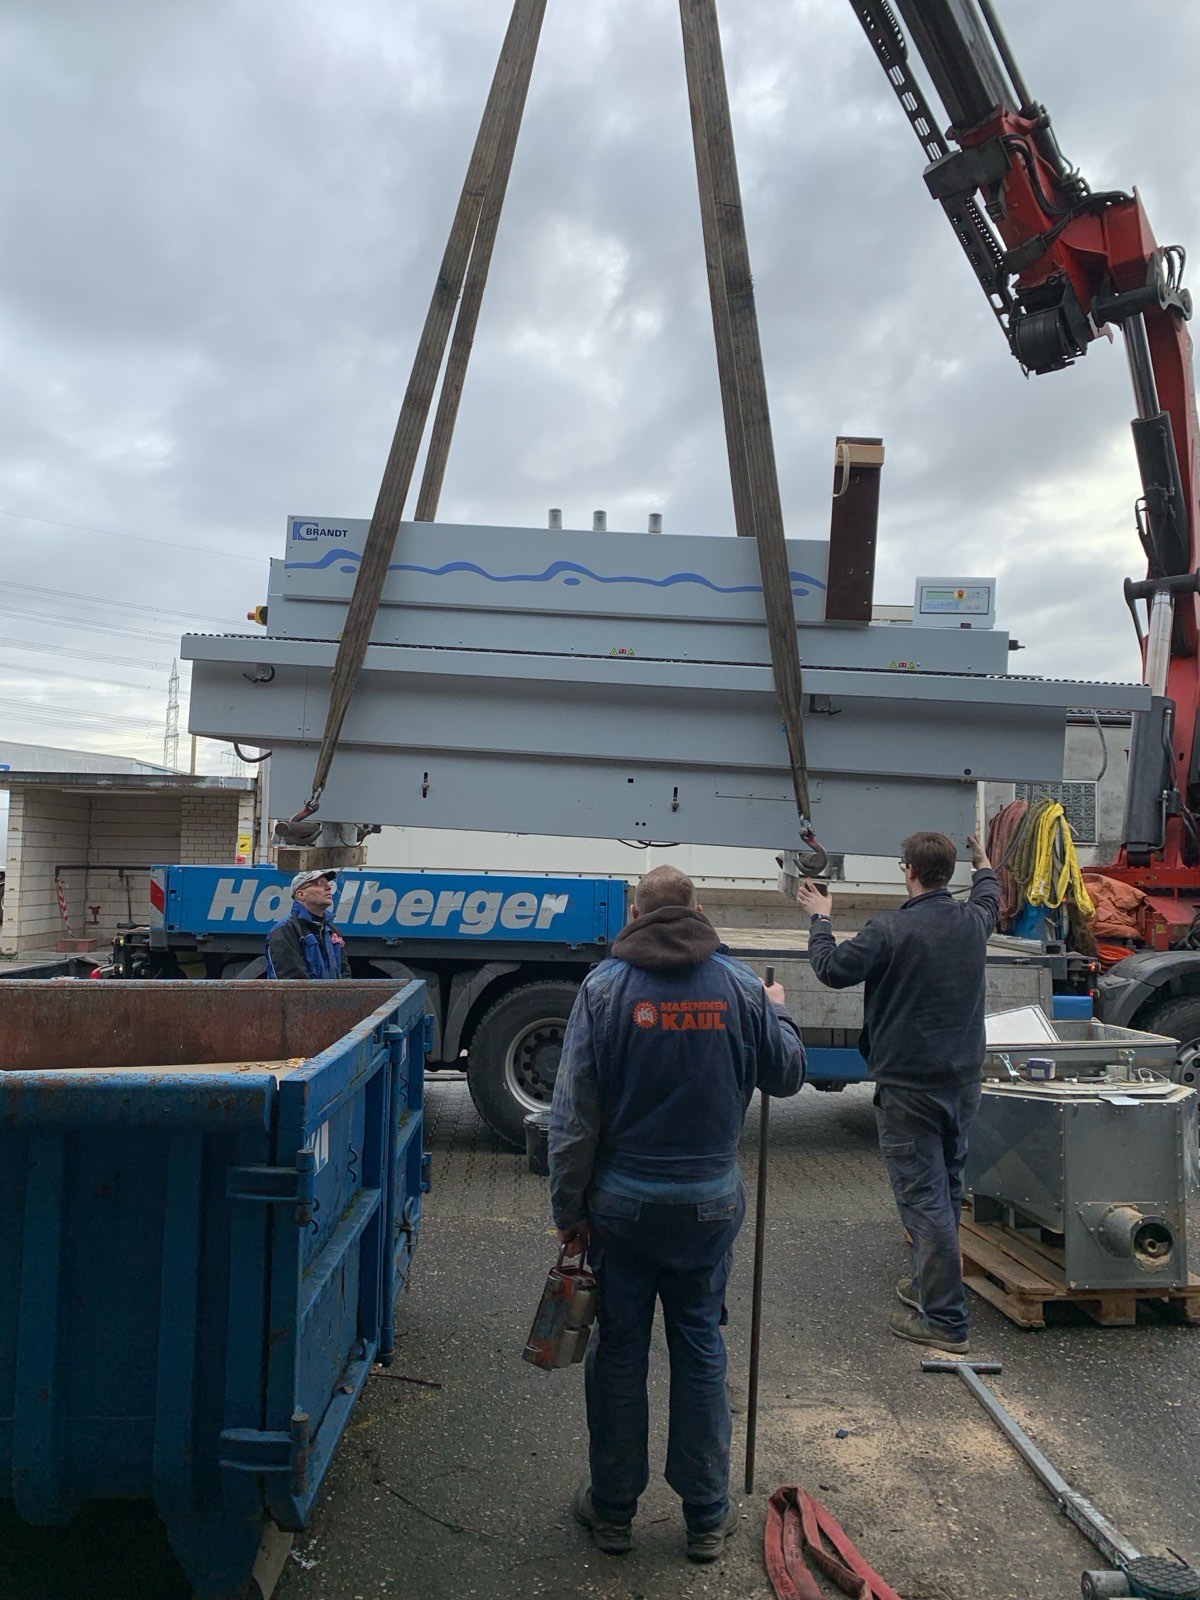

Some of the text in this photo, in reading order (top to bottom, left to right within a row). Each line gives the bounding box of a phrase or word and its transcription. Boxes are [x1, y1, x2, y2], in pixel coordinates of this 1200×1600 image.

[306, 527, 349, 538] BRANDT
[207, 878, 569, 935] Halberger
[660, 1001, 728, 1012] MASCHINEN
[661, 1012, 727, 1031] KAUL
